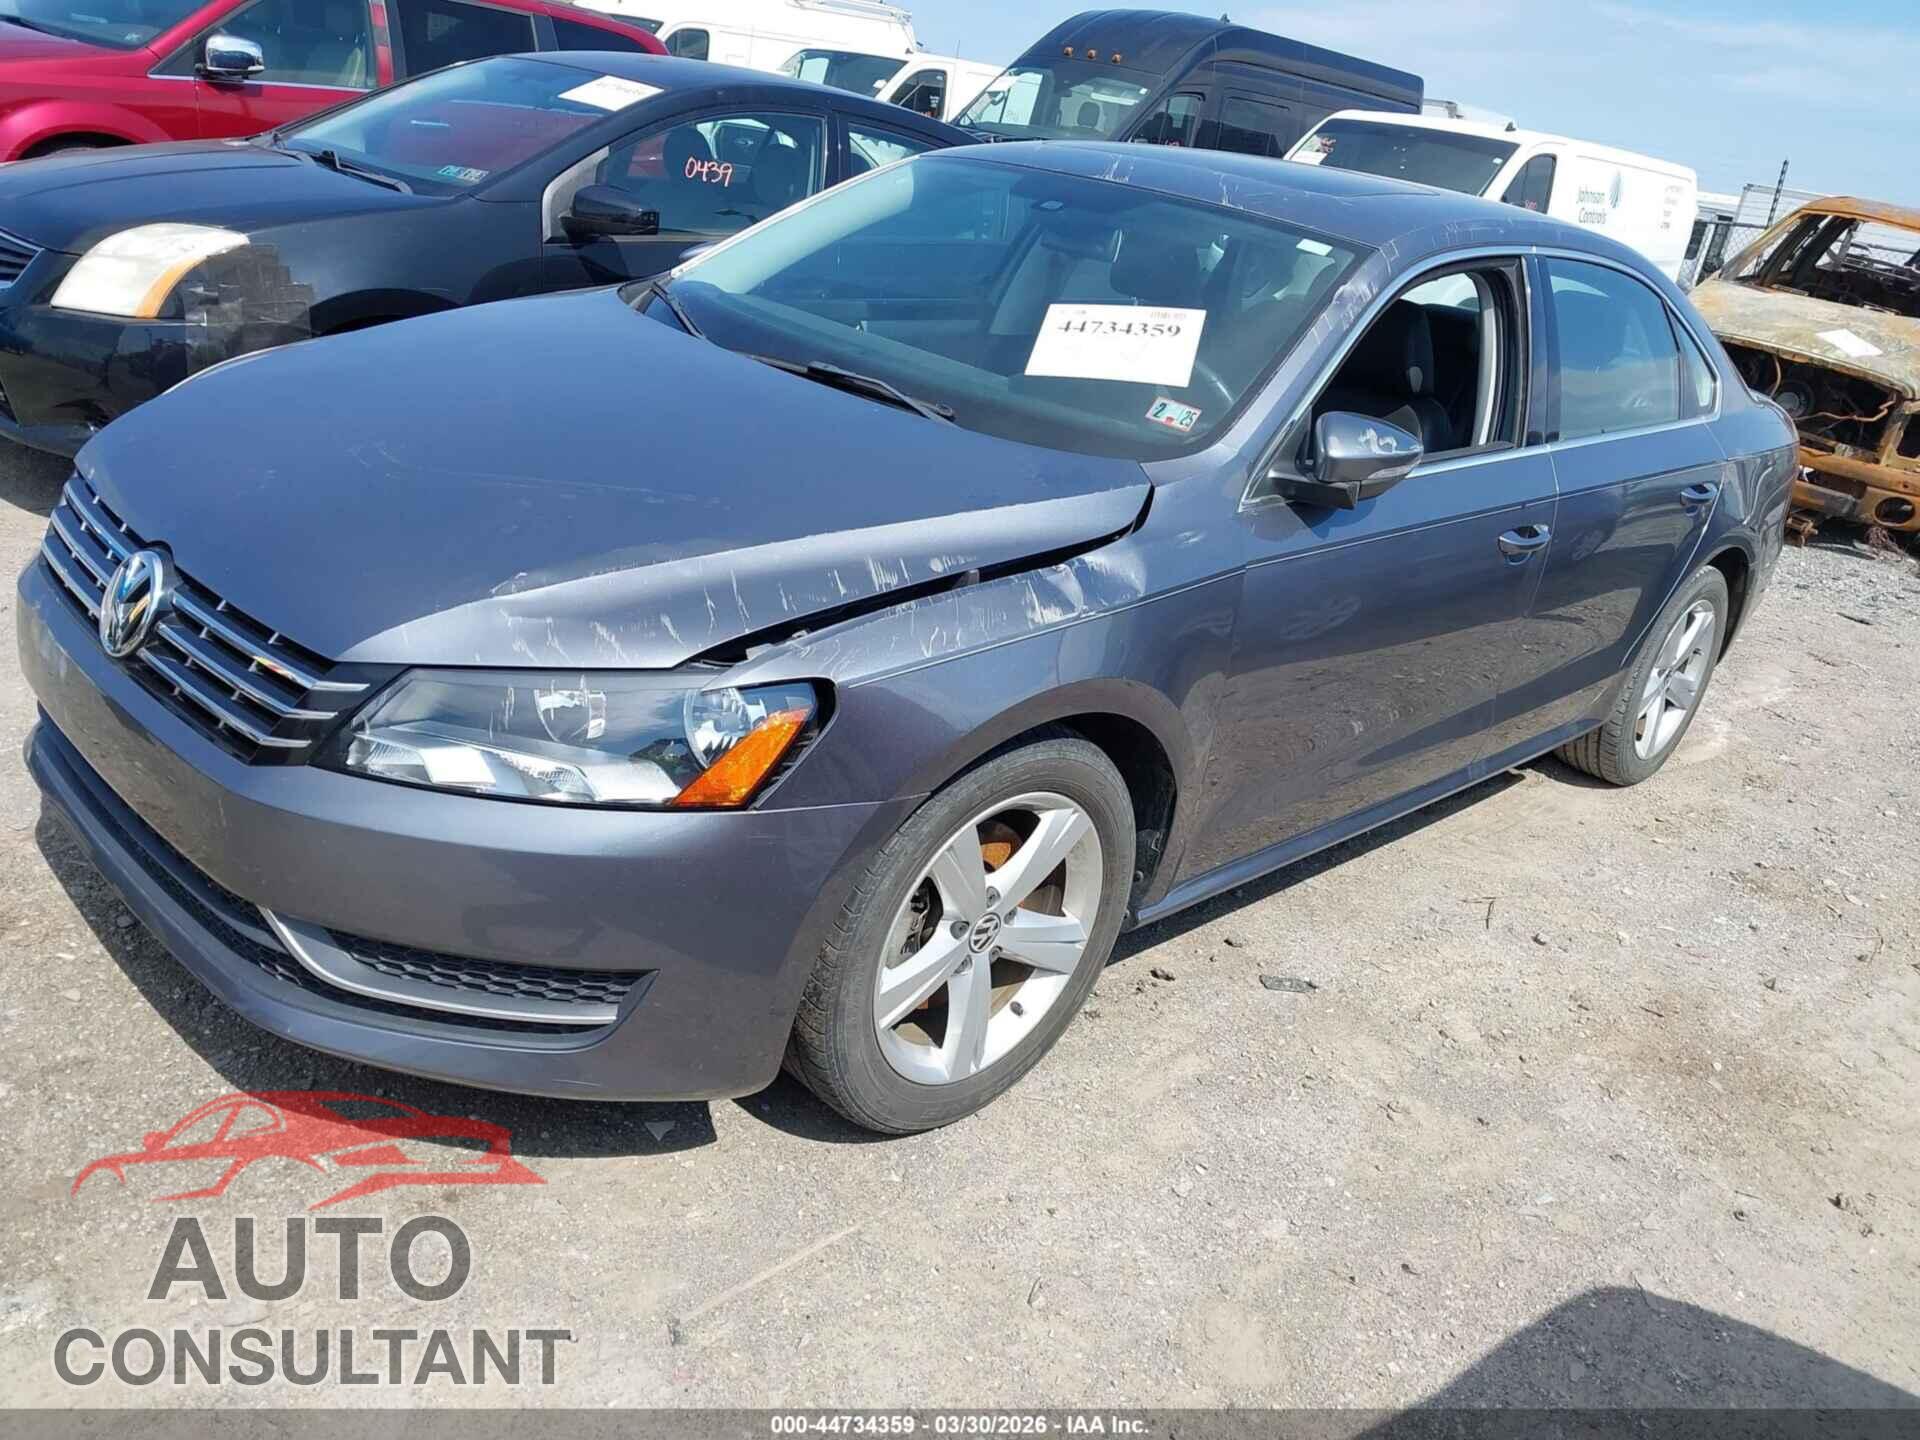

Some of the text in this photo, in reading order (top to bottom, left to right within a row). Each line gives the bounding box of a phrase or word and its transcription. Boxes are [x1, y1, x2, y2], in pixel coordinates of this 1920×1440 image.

[685, 156, 733, 187] 0439
[1576, 184, 1606, 204] Johnson
[1578, 207, 1607, 225] Controls
[1058, 320, 1181, 337] 44734359
